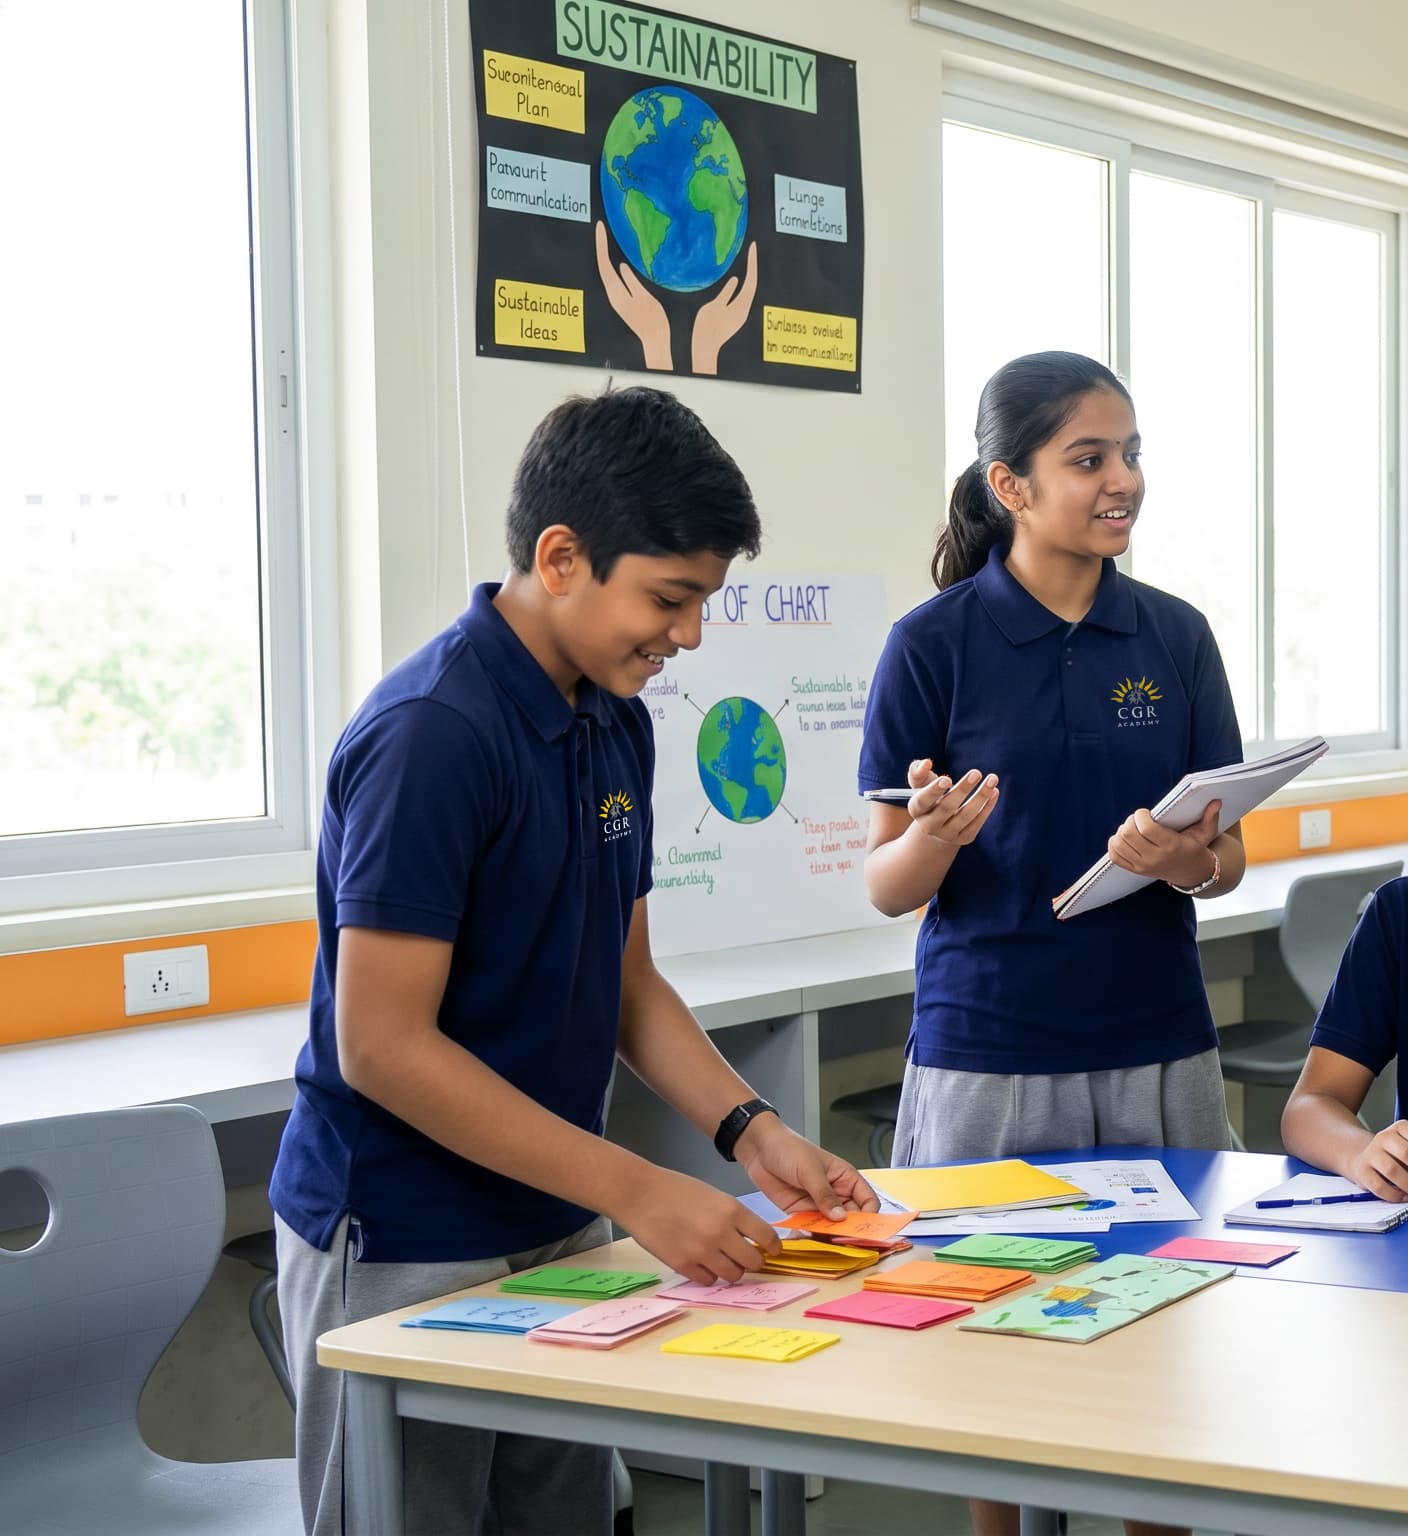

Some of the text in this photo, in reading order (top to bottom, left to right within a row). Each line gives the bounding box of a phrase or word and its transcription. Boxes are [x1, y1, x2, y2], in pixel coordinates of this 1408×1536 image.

[562, 0, 814, 105] SUSTAINABILITY
[517, 92, 550, 118] Plan
[788, 181, 825, 213] Lunge
[497, 285, 580, 318] Sustainable
[520, 319, 559, 342] Ideas
[723, 585, 749, 622] OF
[764, 584, 831, 622] CHART
[791, 673, 853, 694] Sustainable
[1117, 705, 1158, 720] CGR
[1117, 719, 1160, 729] ACADEMY
[603, 816, 631, 834] CGR
